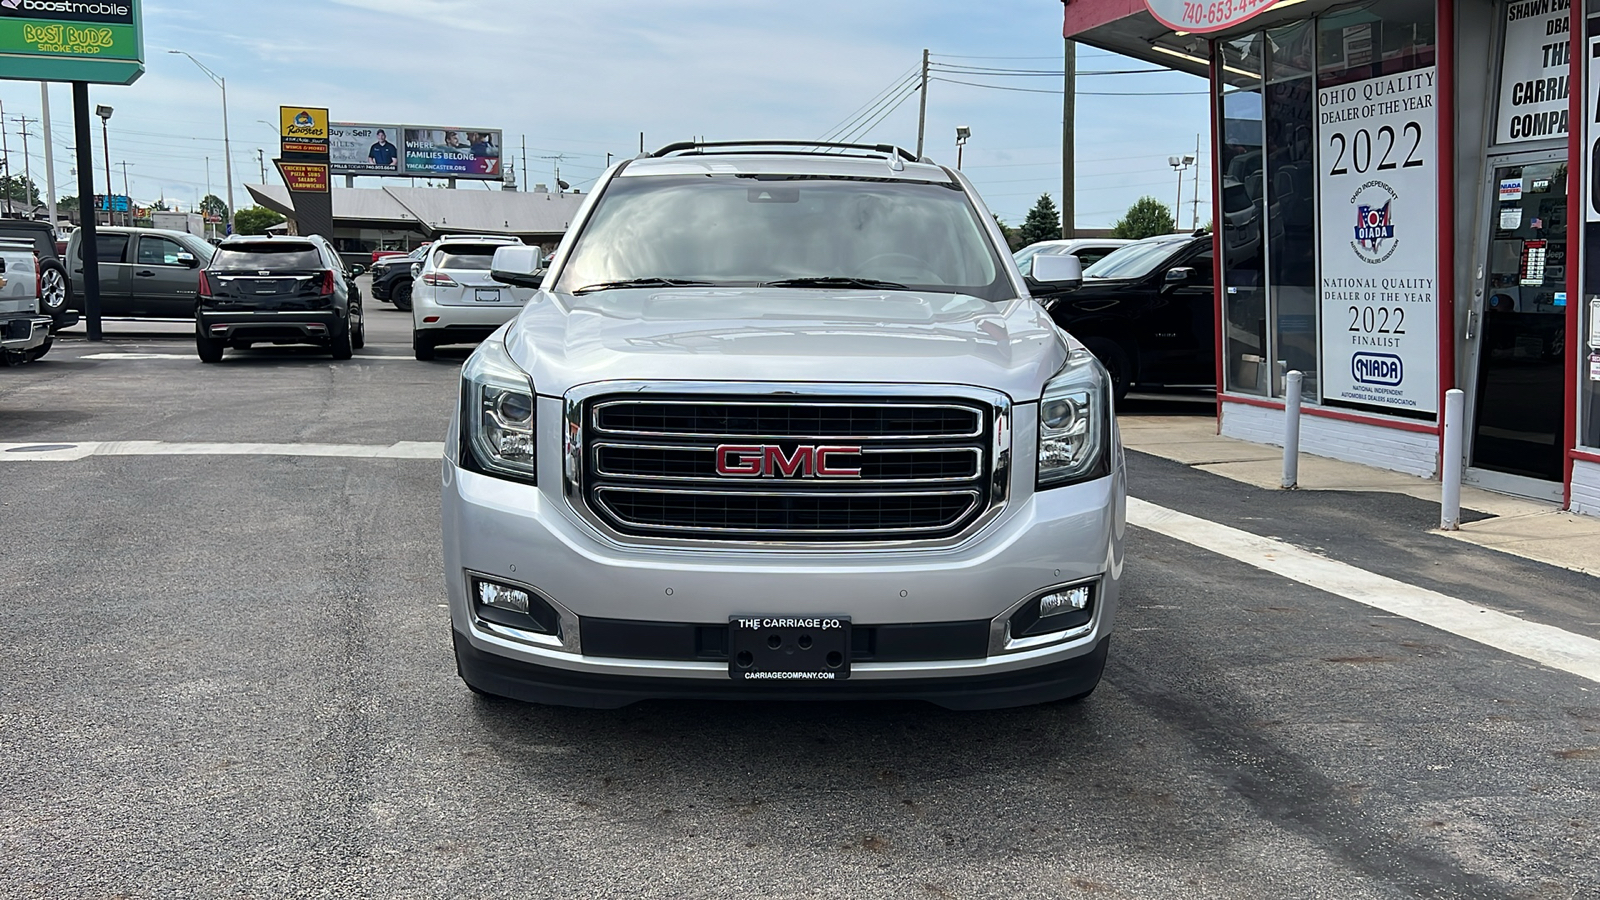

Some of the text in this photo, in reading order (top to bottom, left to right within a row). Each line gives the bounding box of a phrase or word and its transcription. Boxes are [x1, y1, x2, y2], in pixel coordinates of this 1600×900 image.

[24, 0, 128, 15] boostmobile
[1182, 0, 1264, 24] 740-653-44
[1508, 0, 1549, 21] SHAWN
[1546, 16, 1569, 36] DBA
[38, 44, 100, 54] SMOKE SHOP
[1542, 41, 1570, 69] THE
[1320, 87, 1356, 106] OHIO
[1363, 71, 1434, 101] QUALITY
[1321, 107, 1359, 124] DEALER
[1362, 104, 1376, 118] OF
[1378, 100, 1400, 115] THE
[1402, 94, 1432, 111] YEAR
[352, 129, 372, 137] Sell?
[406, 141, 434, 149] WHERE
[1330, 121, 1423, 176] 2022
[406, 151, 477, 161] FAMILIES BELONG.
[1350, 180, 1398, 204] OHIO INDEPENDENT
[1359, 227, 1387, 239] OIADA
[1323, 278, 1433, 290] NATIONAL QUALITY
[1325, 291, 1432, 302] DEALER OF THE YEAR
[1348, 305, 1406, 334] 2022
[1352, 336, 1400, 347] FINALIST
[1355, 358, 1398, 379] NIADA
[1353, 385, 1404, 396] NATIONAL INDEPENDENT
[1387, 397, 1417, 406] ASSOCIATION
[716, 444, 862, 478] GMC
[739, 619, 842, 629] THE CARRIAGE CO.
